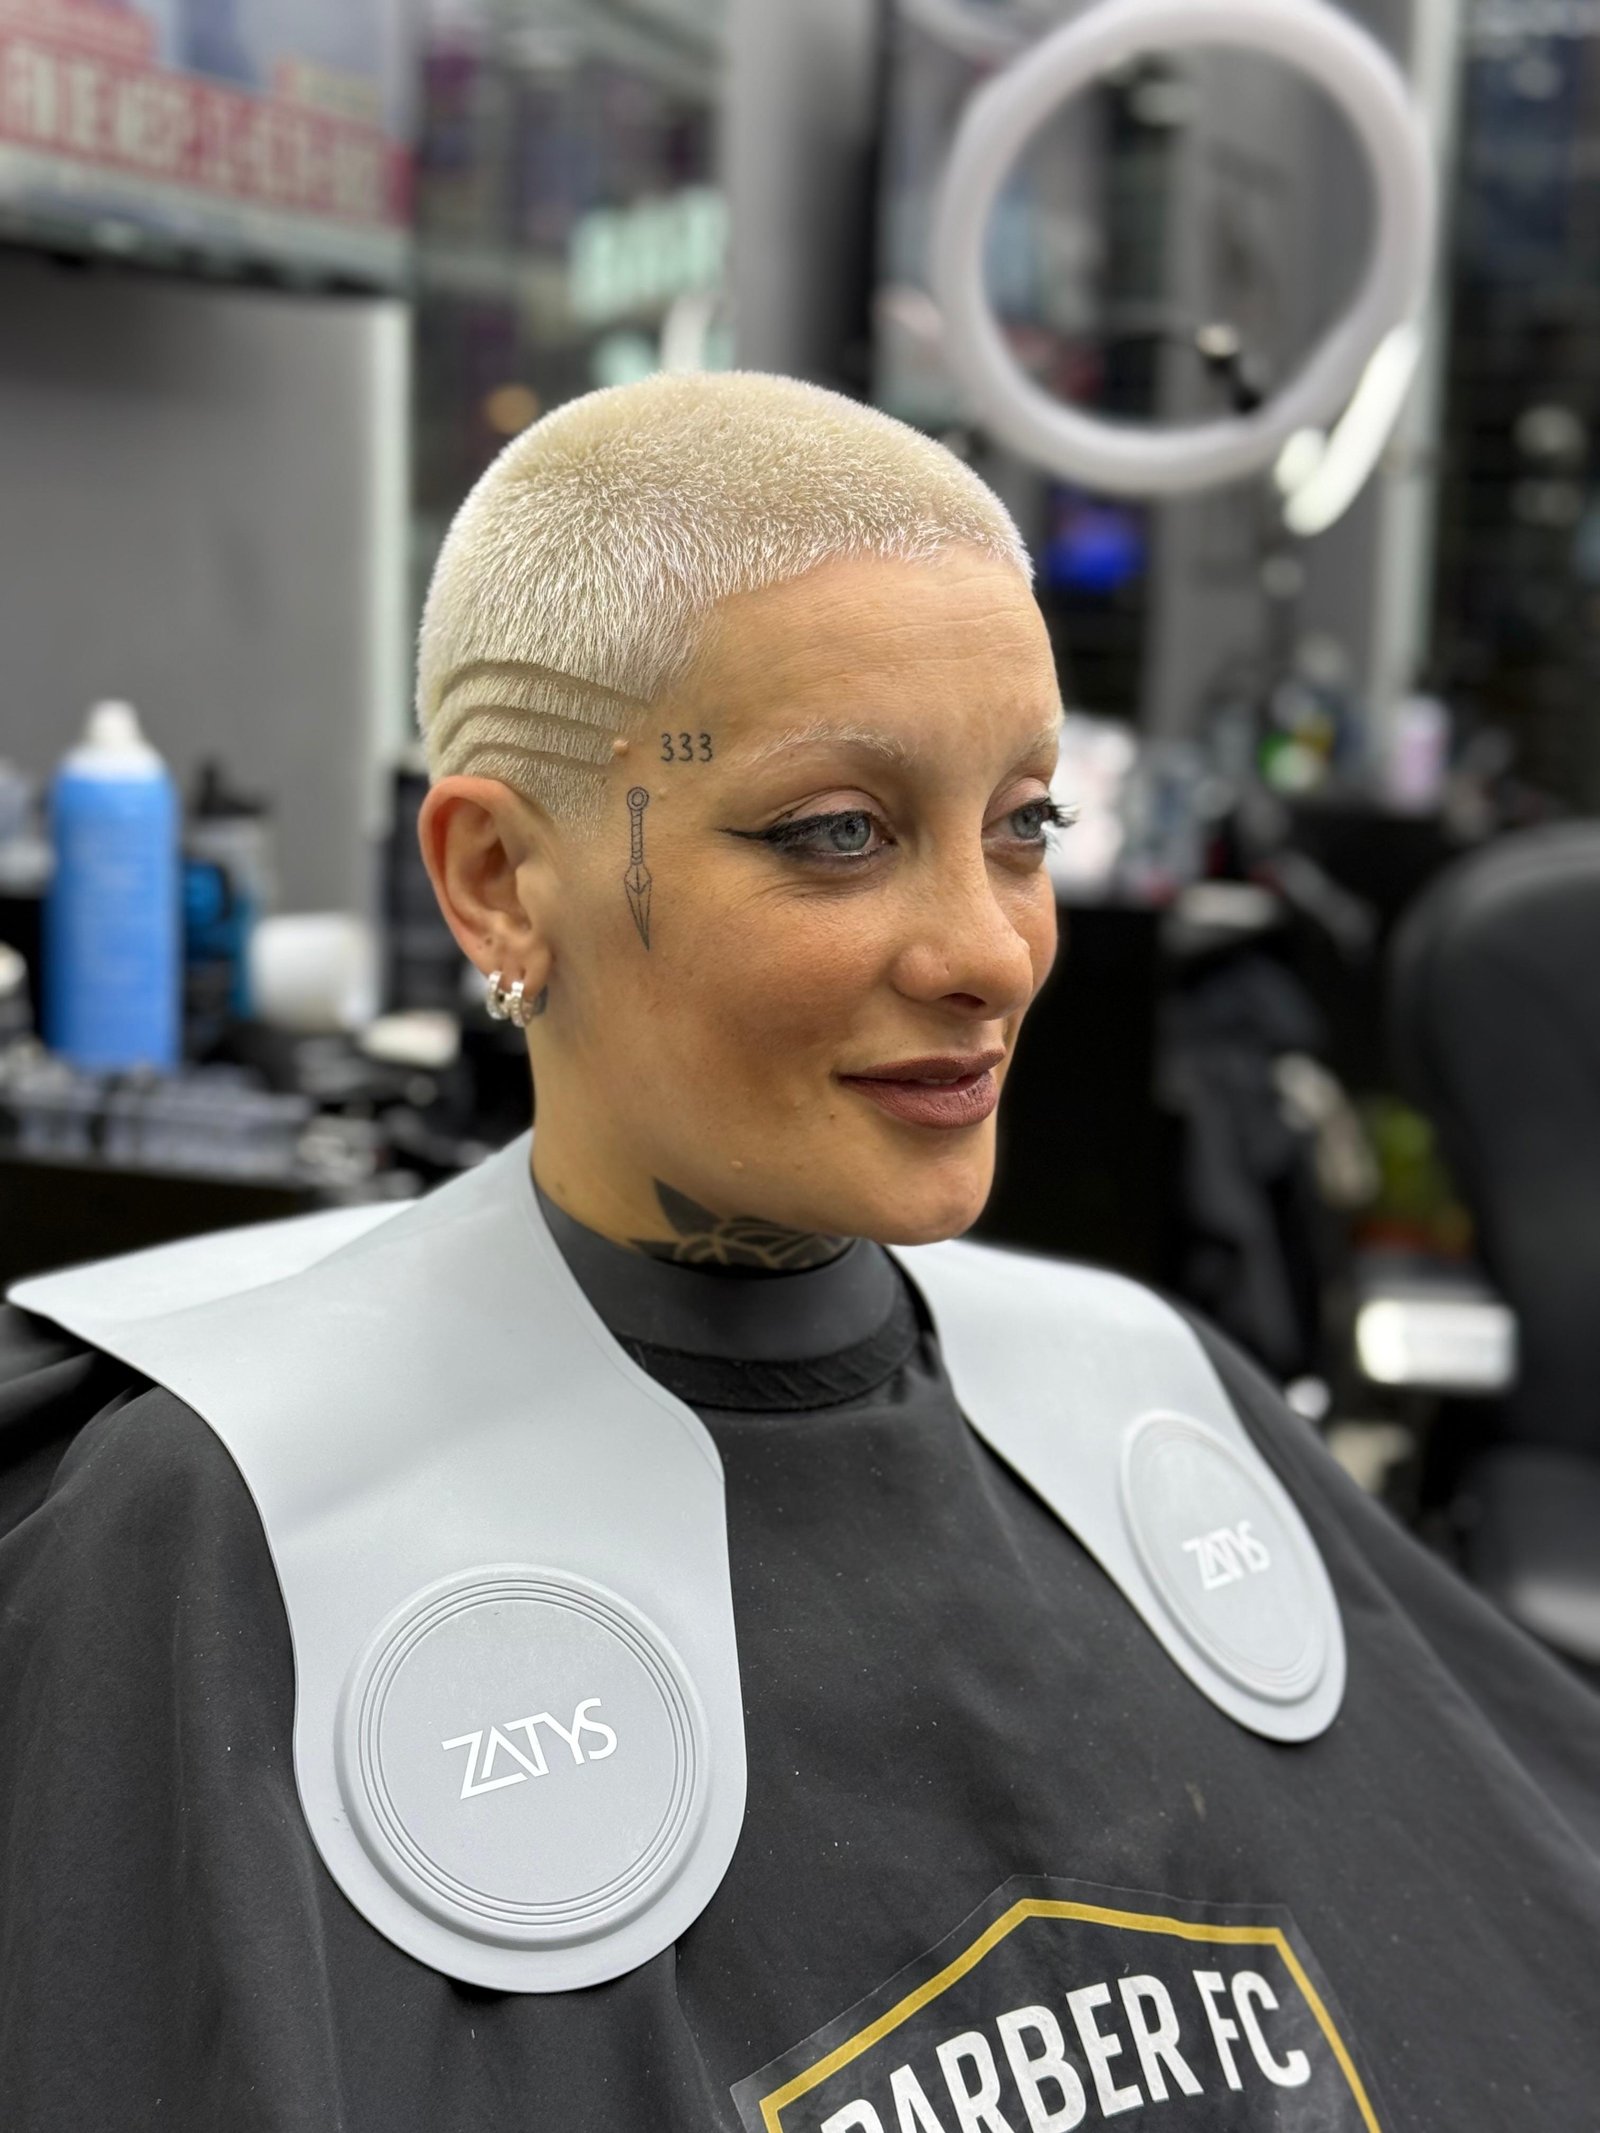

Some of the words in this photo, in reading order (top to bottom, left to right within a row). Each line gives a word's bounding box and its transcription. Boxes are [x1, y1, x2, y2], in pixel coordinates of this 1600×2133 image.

[660, 732, 713, 762] 333
[1181, 1519, 1270, 1591] ZATYS
[440, 1697, 618, 1800] ZATYS
[820, 1974, 1203, 2133] ARBER
[1192, 1970, 1311, 2091] FC
